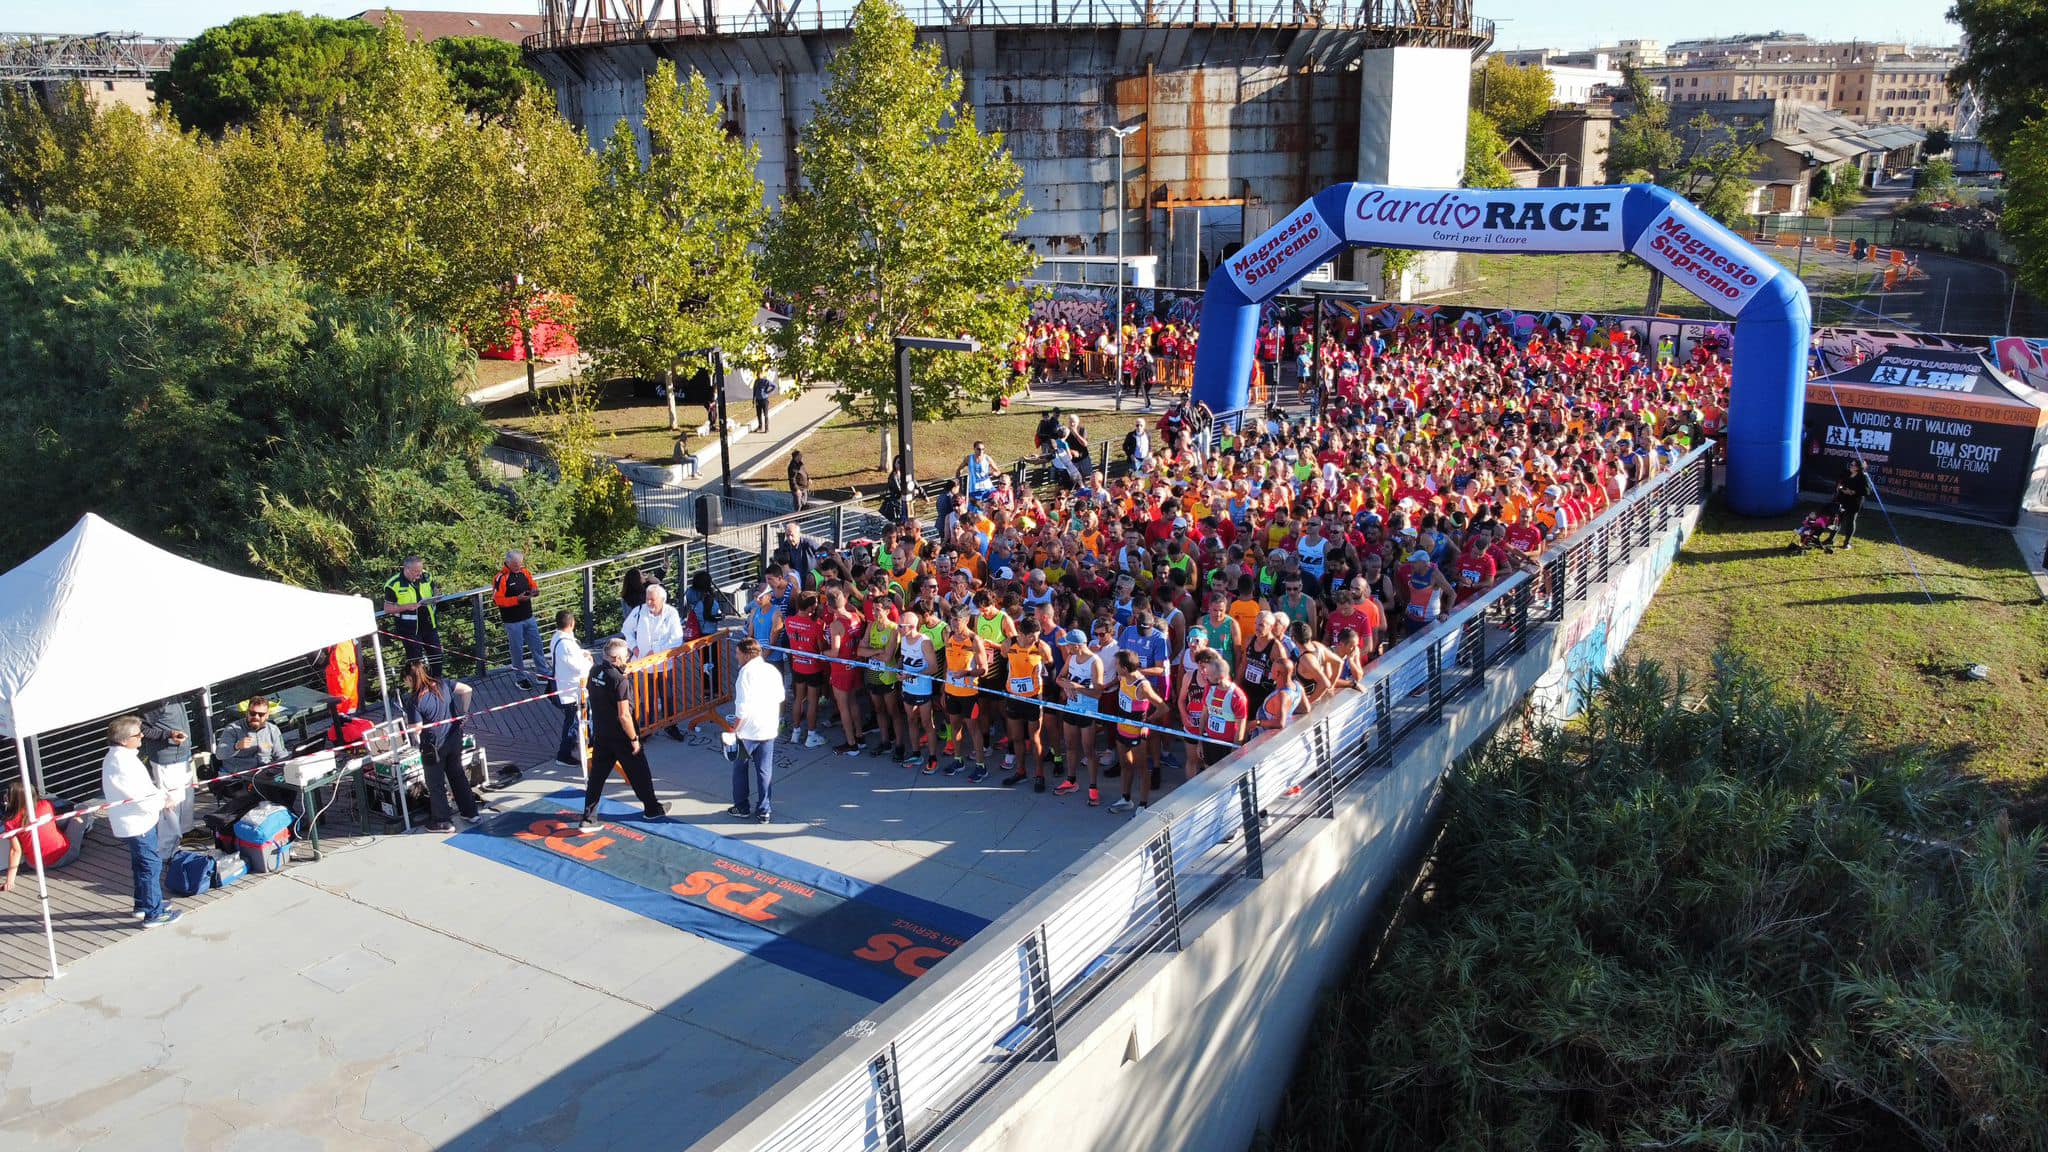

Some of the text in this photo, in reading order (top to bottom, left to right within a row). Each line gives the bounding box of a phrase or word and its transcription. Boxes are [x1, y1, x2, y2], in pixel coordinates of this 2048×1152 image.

[1482, 202, 1611, 232] RACE
[1233, 211, 1313, 276] Magnesio
[1432, 230, 1527, 244] Corri per il Cuore
[1244, 226, 1319, 285] Supremo
[1656, 216, 1758, 286] Magnesio
[1650, 235, 1740, 298] Supremo
[1880, 356, 1983, 374] FOOTWORKS
[1906, 368, 1978, 393] LBM
[1964, 405, 1982, 417] PER
[1852, 411, 1972, 437] NORDIC & FIT WALKING
[1848, 427, 1892, 452] LBM
[1929, 439, 2001, 463] LBM SPORT
[1936, 455, 1990, 473] TEAM ROMA
[1016, 683, 1027, 693] 20
[711, 858, 816, 898] TIMING DATA SERVICE
[670, 871, 784, 922] TDS
[892, 919, 941, 939] SERVICE
[852, 933, 949, 979] DS
